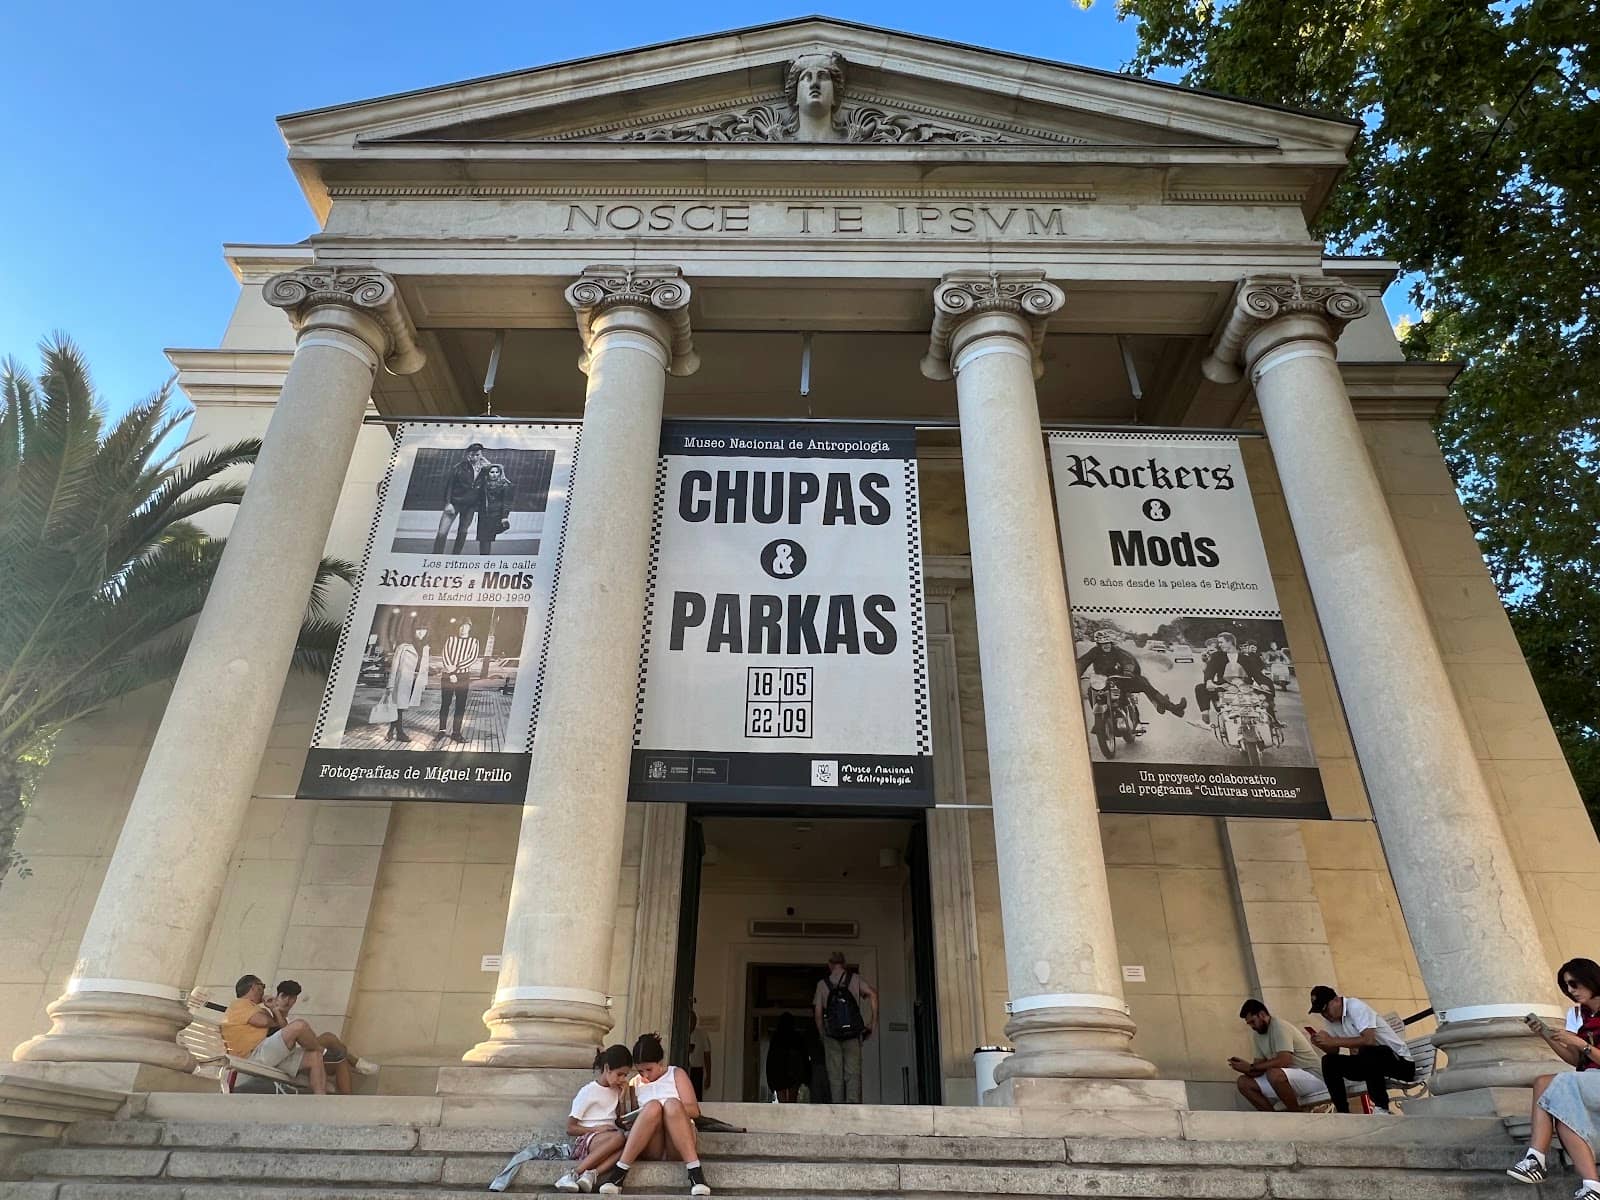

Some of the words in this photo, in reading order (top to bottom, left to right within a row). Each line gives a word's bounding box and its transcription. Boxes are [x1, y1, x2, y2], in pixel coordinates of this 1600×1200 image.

[563, 204, 750, 233] NOSCE
[786, 206, 864, 234] TE
[895, 206, 1068, 236] IPSVM
[684, 437, 725, 449] Museo
[729, 438, 784, 450] Nacional
[789, 439, 803, 450] de
[807, 439, 890, 454] Antropología
[1066, 454, 1235, 491] Rockers
[678, 469, 892, 526] CHUPAS
[1108, 530, 1220, 568] Mods
[421, 558, 442, 569] Los
[444, 560, 481, 570] ritmos
[483, 560, 496, 570] de
[499, 560, 509, 570] la
[512, 560, 537, 570] calle
[379, 568, 464, 589] Rockers
[481, 571, 534, 590] Mods
[1083, 577, 1097, 588] 60
[1099, 577, 1124, 588] años
[1126, 578, 1155, 588] desde
[1158, 578, 1169, 588] la
[1171, 579, 1198, 591] pelea
[1200, 579, 1212, 589] de
[1214, 580, 1259, 592] Brighton
[421, 593, 435, 602] en
[437, 592, 473, 602] Madrid
[477, 592, 531, 603] 1980-1990
[669, 591, 898, 656] PARKAS
[753, 672, 773, 696] 18
[783, 672, 807, 696] 05
[752, 708, 772, 733] 22
[783, 708, 807, 733] 09
[319, 764, 400, 781] Fotografías
[403, 766, 420, 780] de
[423, 766, 471, 783] Miguel
[474, 767, 512, 783] Trillo
[841, 764, 871, 774] Museo
[842, 774, 853, 783] de
[1138, 770, 1156, 782] Un
[1158, 772, 1206, 786] proyecto
[1208, 772, 1277, 786] colaborativo
[1118, 782, 1136, 794] del
[1138, 785, 1193, 797] programa
